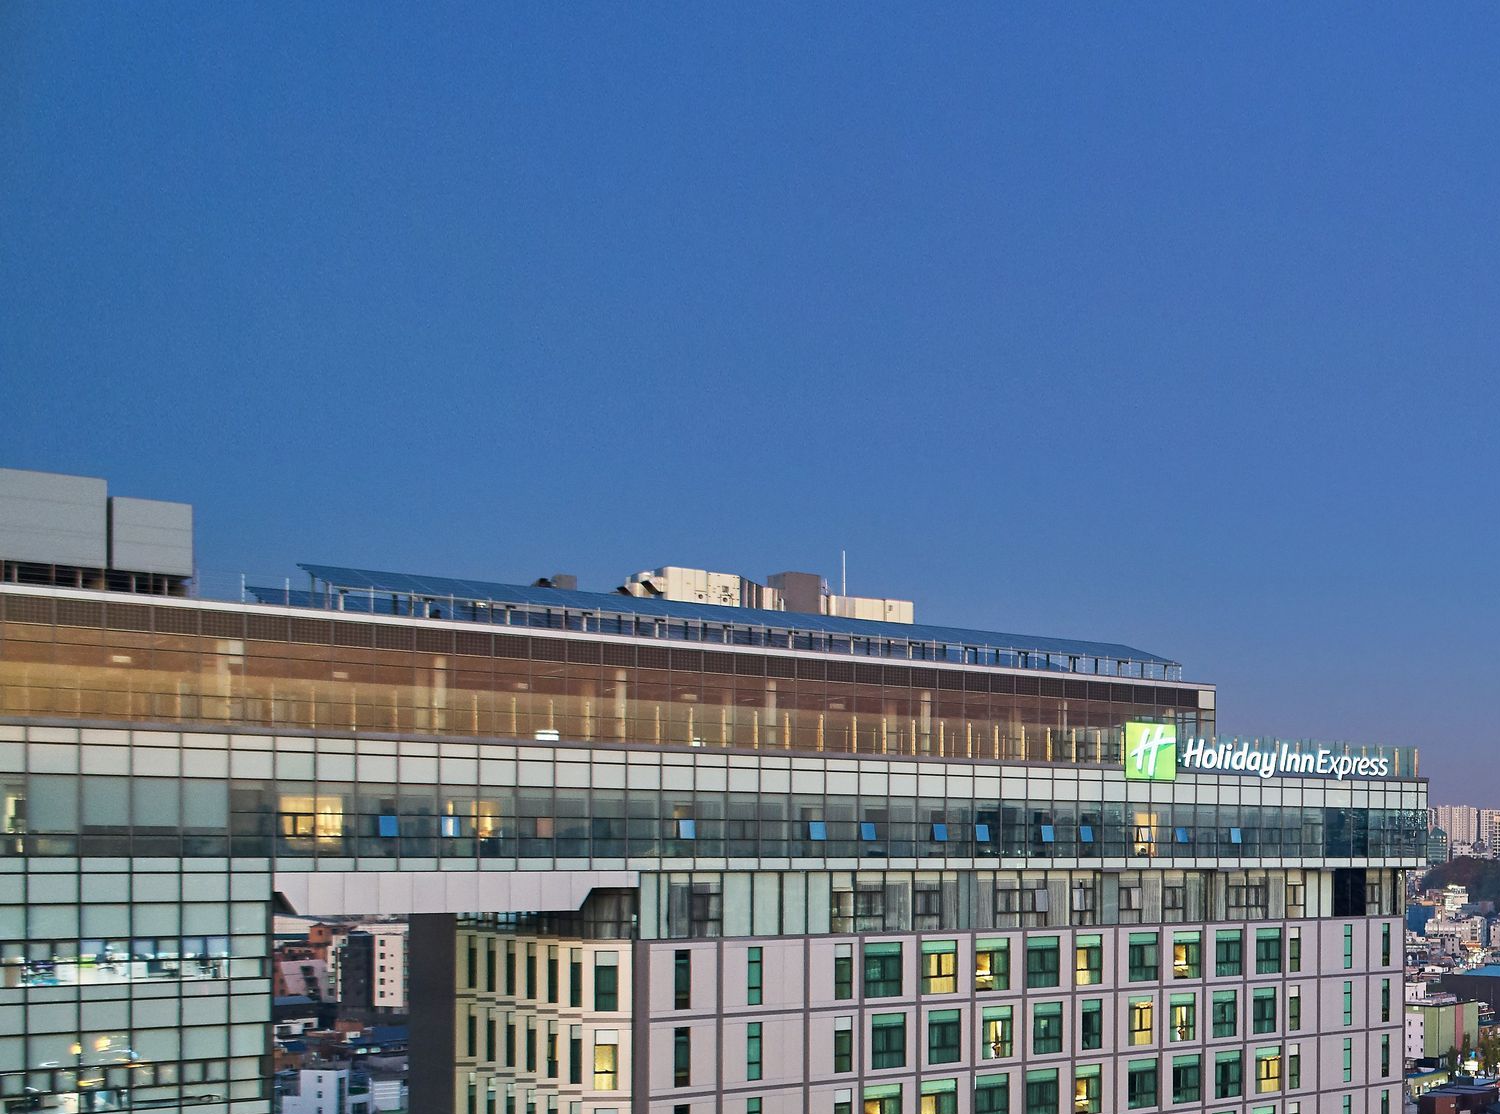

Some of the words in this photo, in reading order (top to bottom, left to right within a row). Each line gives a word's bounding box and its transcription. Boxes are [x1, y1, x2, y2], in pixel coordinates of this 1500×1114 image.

[1182, 738, 1277, 778] Holiday
[1280, 743, 1315, 774] Inn
[1316, 749, 1390, 780] Express
